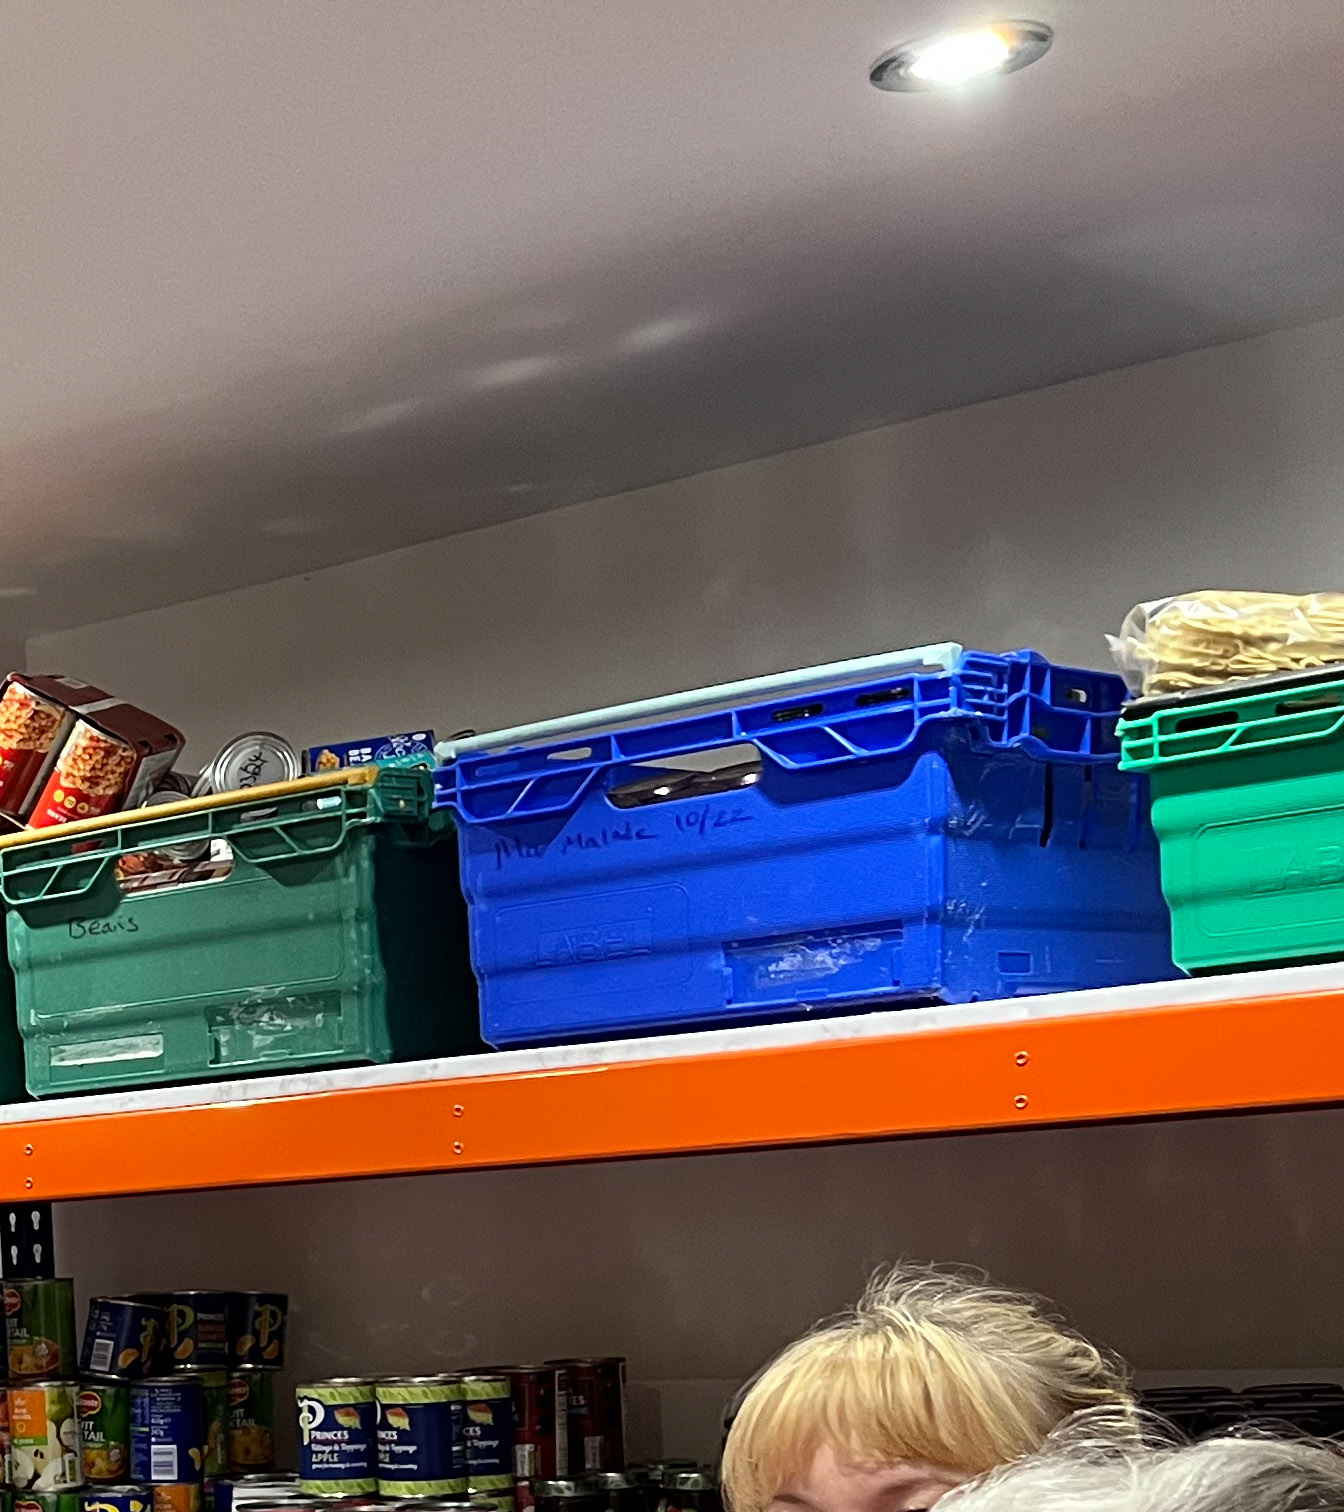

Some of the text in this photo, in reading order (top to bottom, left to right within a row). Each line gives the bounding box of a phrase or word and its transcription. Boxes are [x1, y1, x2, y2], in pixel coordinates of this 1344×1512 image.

[67, 915, 140, 940] Beans
[311, 1430, 349, 1441] PRINCES
[312, 1452, 340, 1463] APPLE
